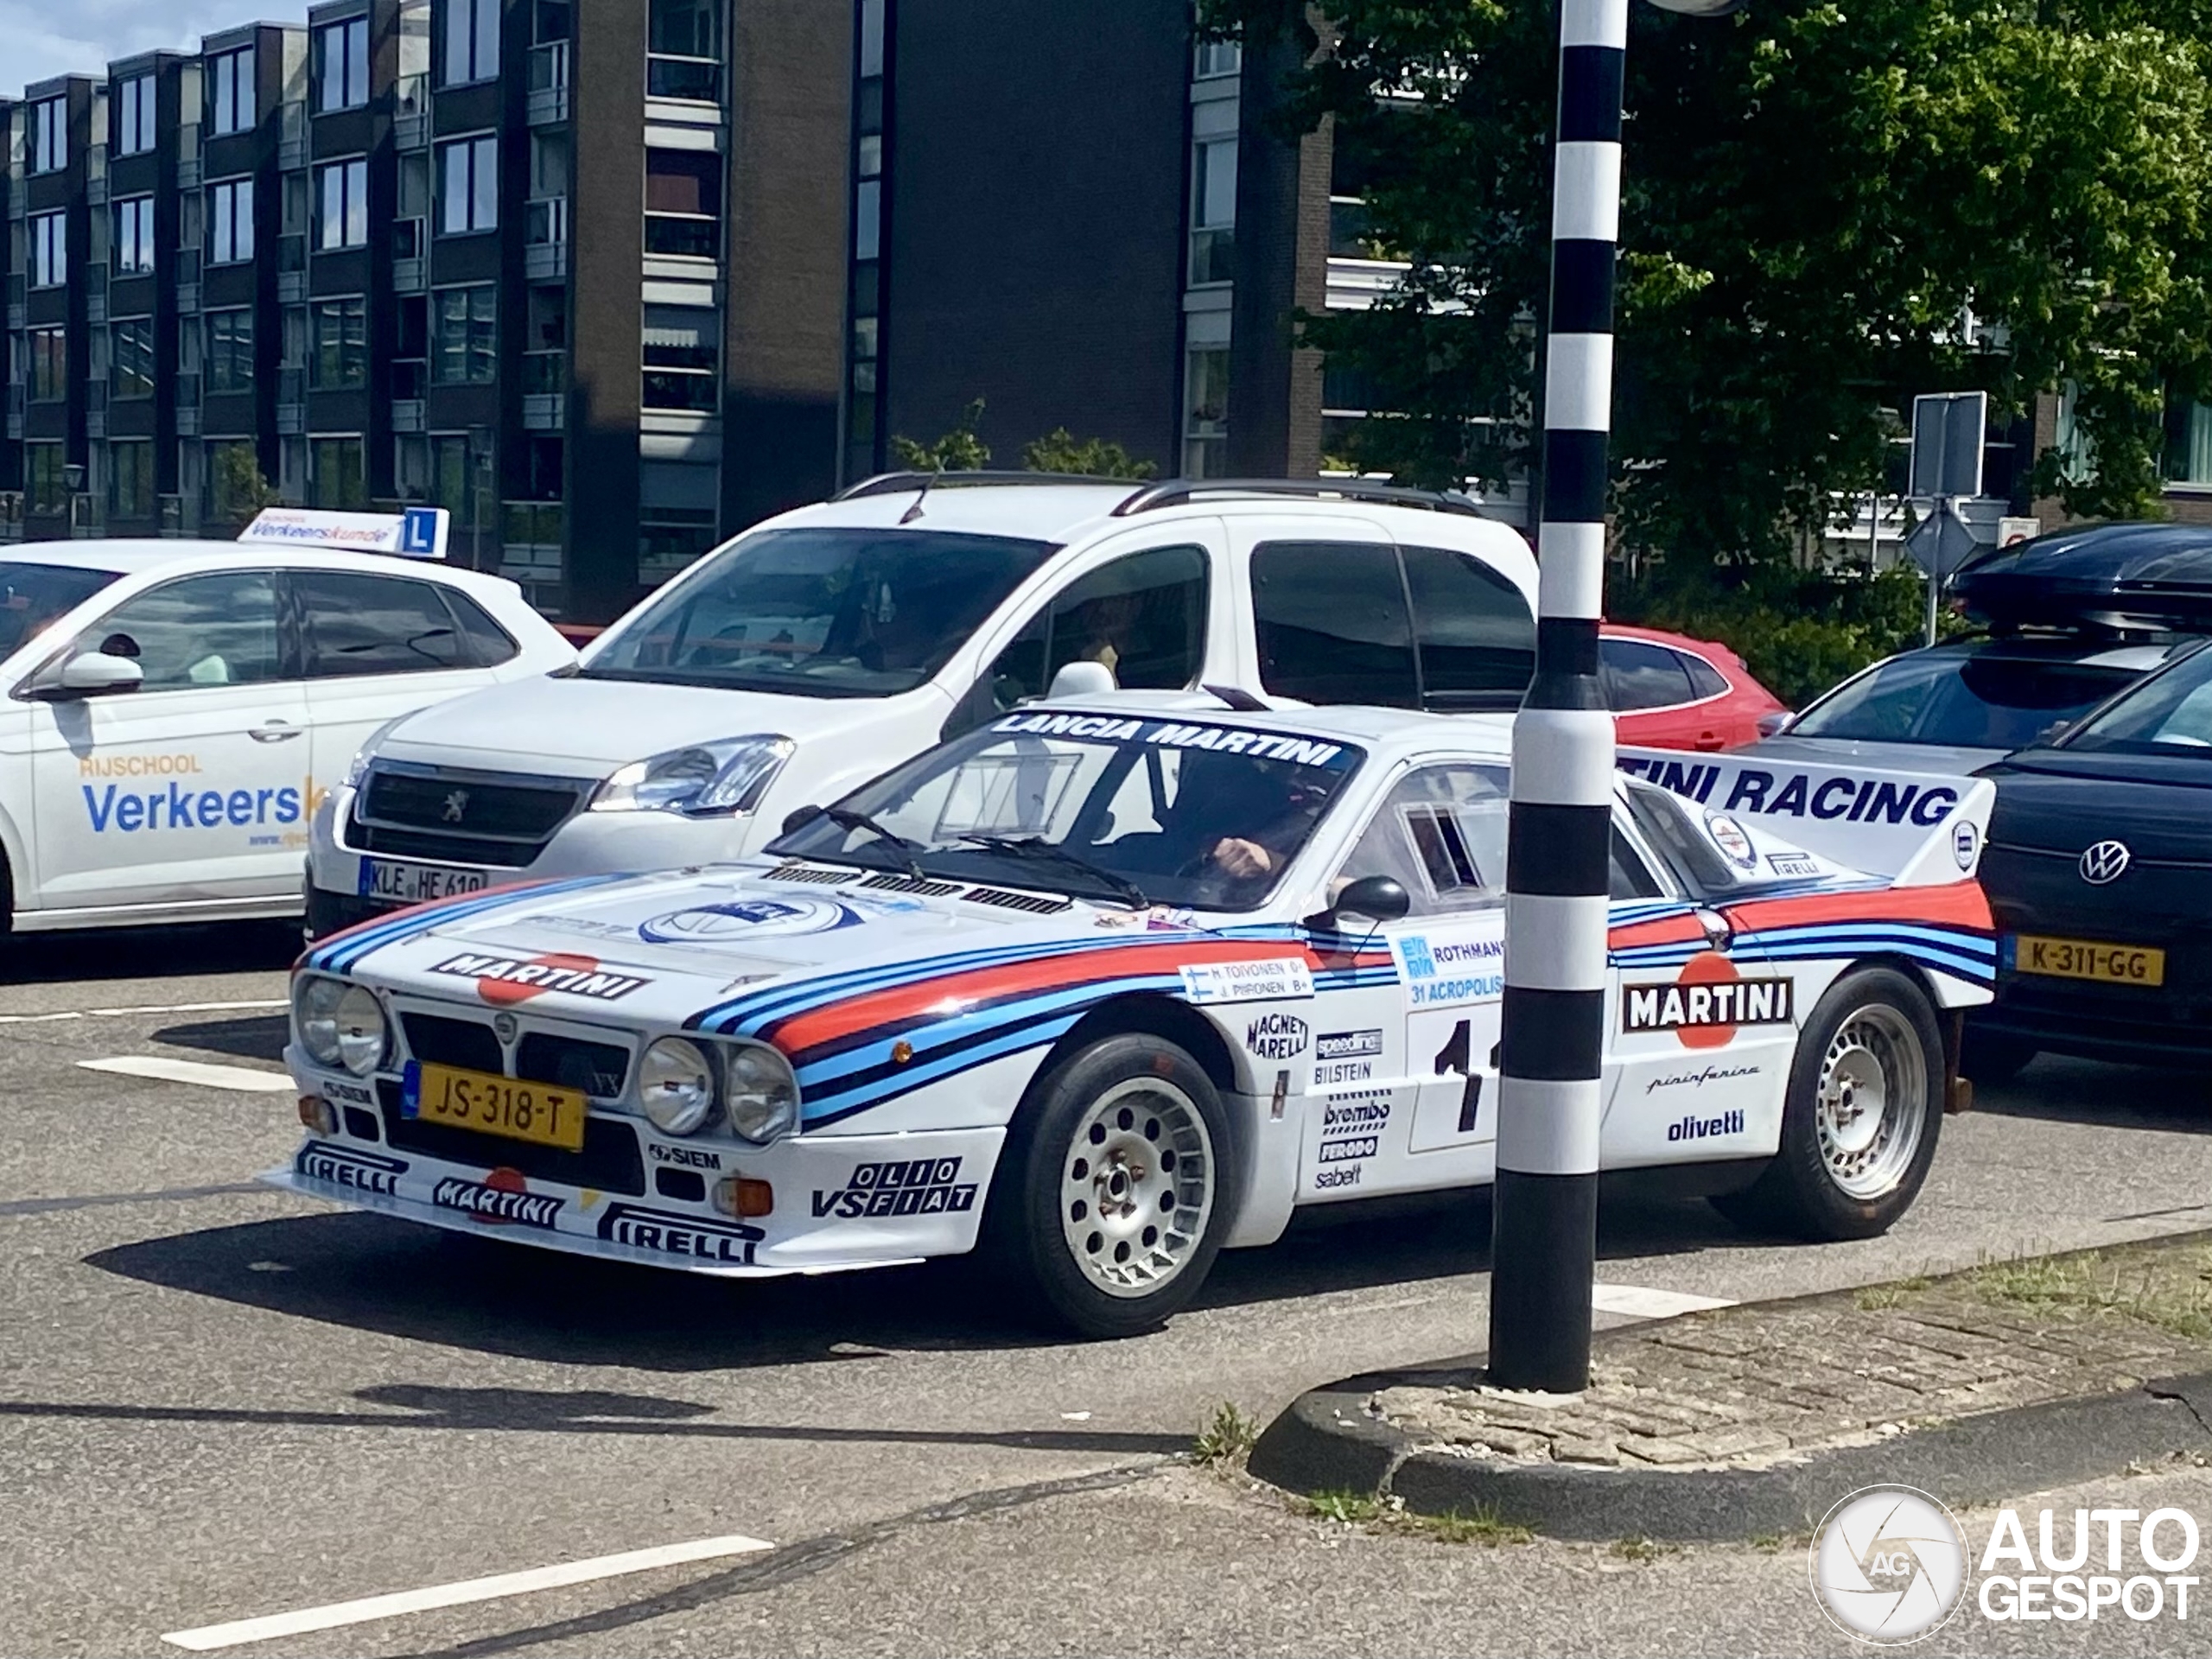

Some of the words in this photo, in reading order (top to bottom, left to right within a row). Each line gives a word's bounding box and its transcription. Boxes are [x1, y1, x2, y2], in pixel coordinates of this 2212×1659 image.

[410, 516, 428, 548] L
[991, 714, 1143, 741] LANCIA
[1147, 724, 1341, 766] MARTINI
[79, 754, 201, 777] RIJSCHOOL
[82, 775, 326, 832] Verkeersk
[1723, 770, 1958, 827] RACING
[1764, 853, 1819, 876] PIRELLI
[371, 866, 404, 896] KLE
[1433, 940, 1504, 963] ROTHMAN
[2032, 942, 2146, 979] K-311-GG
[438, 955, 640, 998] MARTINI
[1224, 963, 1286, 979] TOIVONEN
[1411, 984, 1426, 1003] 31
[1630, 982, 1787, 1028] MARTINI
[1314, 1062, 1371, 1084] BILSTEIN
[1646, 1065, 1761, 1095] pininfarina
[435, 1077, 565, 1135] JS-318-T
[1324, 1100, 1390, 1125] brembo
[1669, 1109, 1745, 1141] olivetti
[671, 1147, 721, 1170] SIEM
[1321, 1138, 1376, 1161] FERODO
[297, 1140, 410, 1196] PIRELLI
[856, 1161, 955, 1185] OLIO
[1315, 1163, 1361, 1189] sabelt
[437, 1180, 556, 1225] MARTINI
[872, 1188, 977, 1213] FIAT
[597, 1201, 766, 1264] PIRELLI
